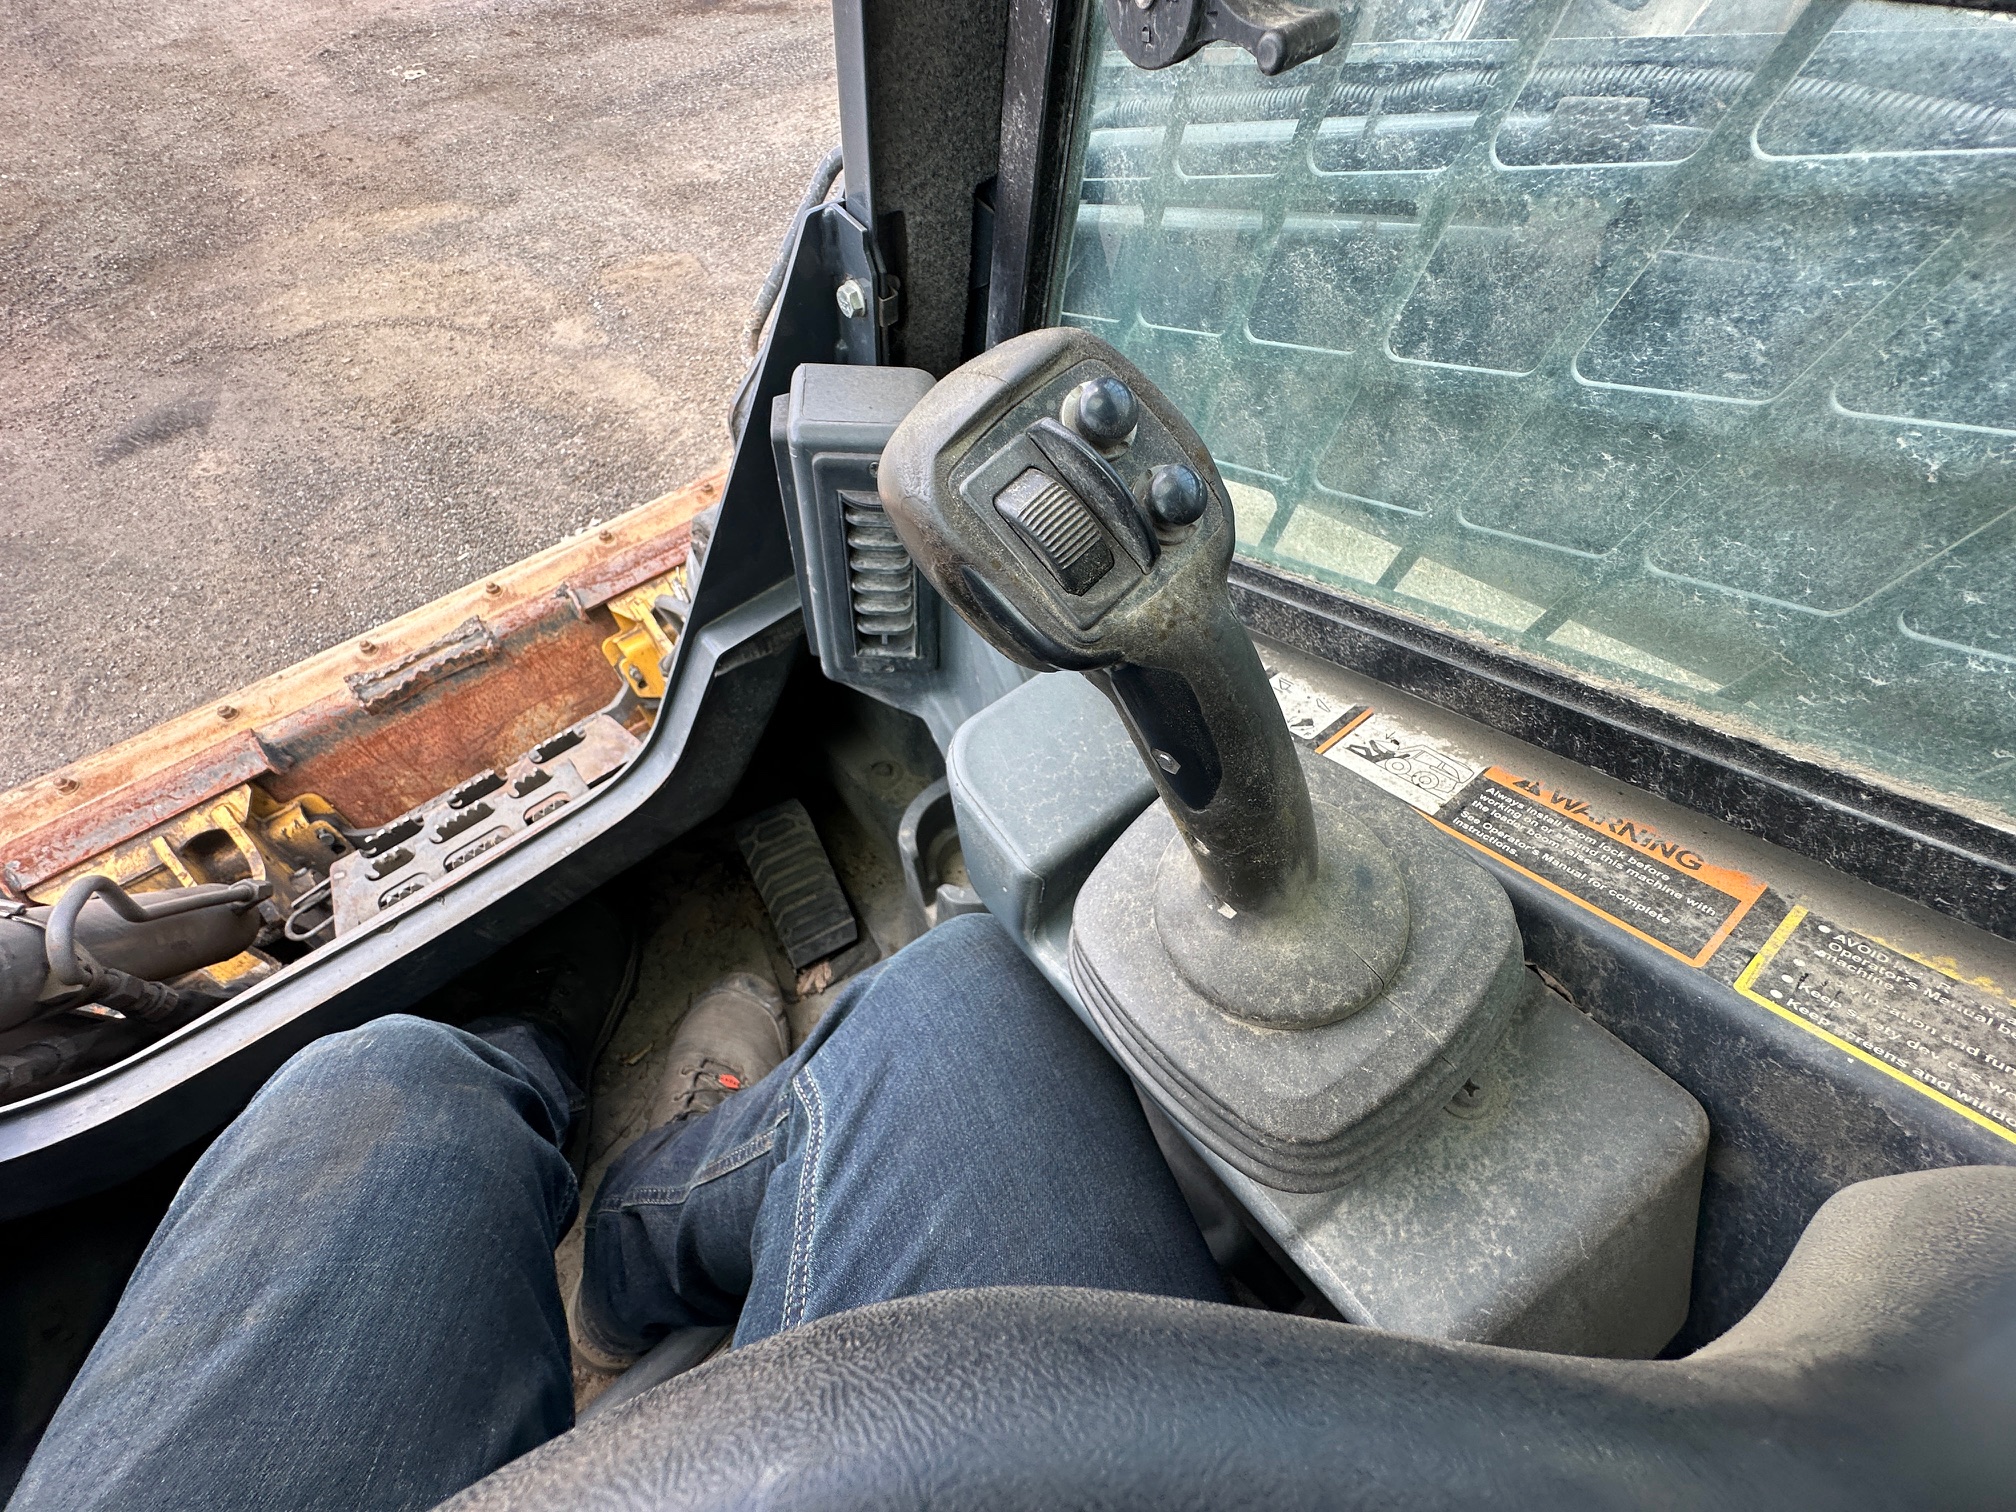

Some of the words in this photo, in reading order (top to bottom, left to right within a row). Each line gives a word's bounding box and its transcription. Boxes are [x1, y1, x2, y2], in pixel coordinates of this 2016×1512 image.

[1452, 817, 1519, 857] instructions.
[1472, 800, 1489, 813] the
[1491, 809, 1527, 832] loader
[1526, 828, 1560, 849] boom
[1486, 787, 1524, 810] Always
[1526, 806, 1562, 827] install
[1563, 824, 1597, 845] boom
[1599, 842, 1626, 860] lock
[1627, 856, 1670, 881] before
[1460, 810, 1481, 825] See
[1482, 822, 1540, 856] Operator's
[1541, 853, 1588, 880] Manual
[1587, 877, 1607, 890] for
[1608, 889, 1671, 924] complete
[1479, 793, 1522, 819] working
[1523, 816, 1539, 828] on
[1540, 825, 1555, 836] or
[1600, 854, 1624, 870] this
[1626, 867, 1683, 900] machine
[1686, 897, 1716, 917] with
[1822, 951, 1897, 993] machine.
[1828, 942, 1918, 990] Operator's
[1833, 934, 1890, 964] AVOID
[1786, 998, 1832, 1027] Keep
[1833, 1025, 1909, 1069] creens
[1912, 1067, 1951, 1092] and
[1798, 981, 1843, 1009] Keep
[1906, 1039, 1982, 1082] devces
[1941, 1034, 1980, 1057] and
